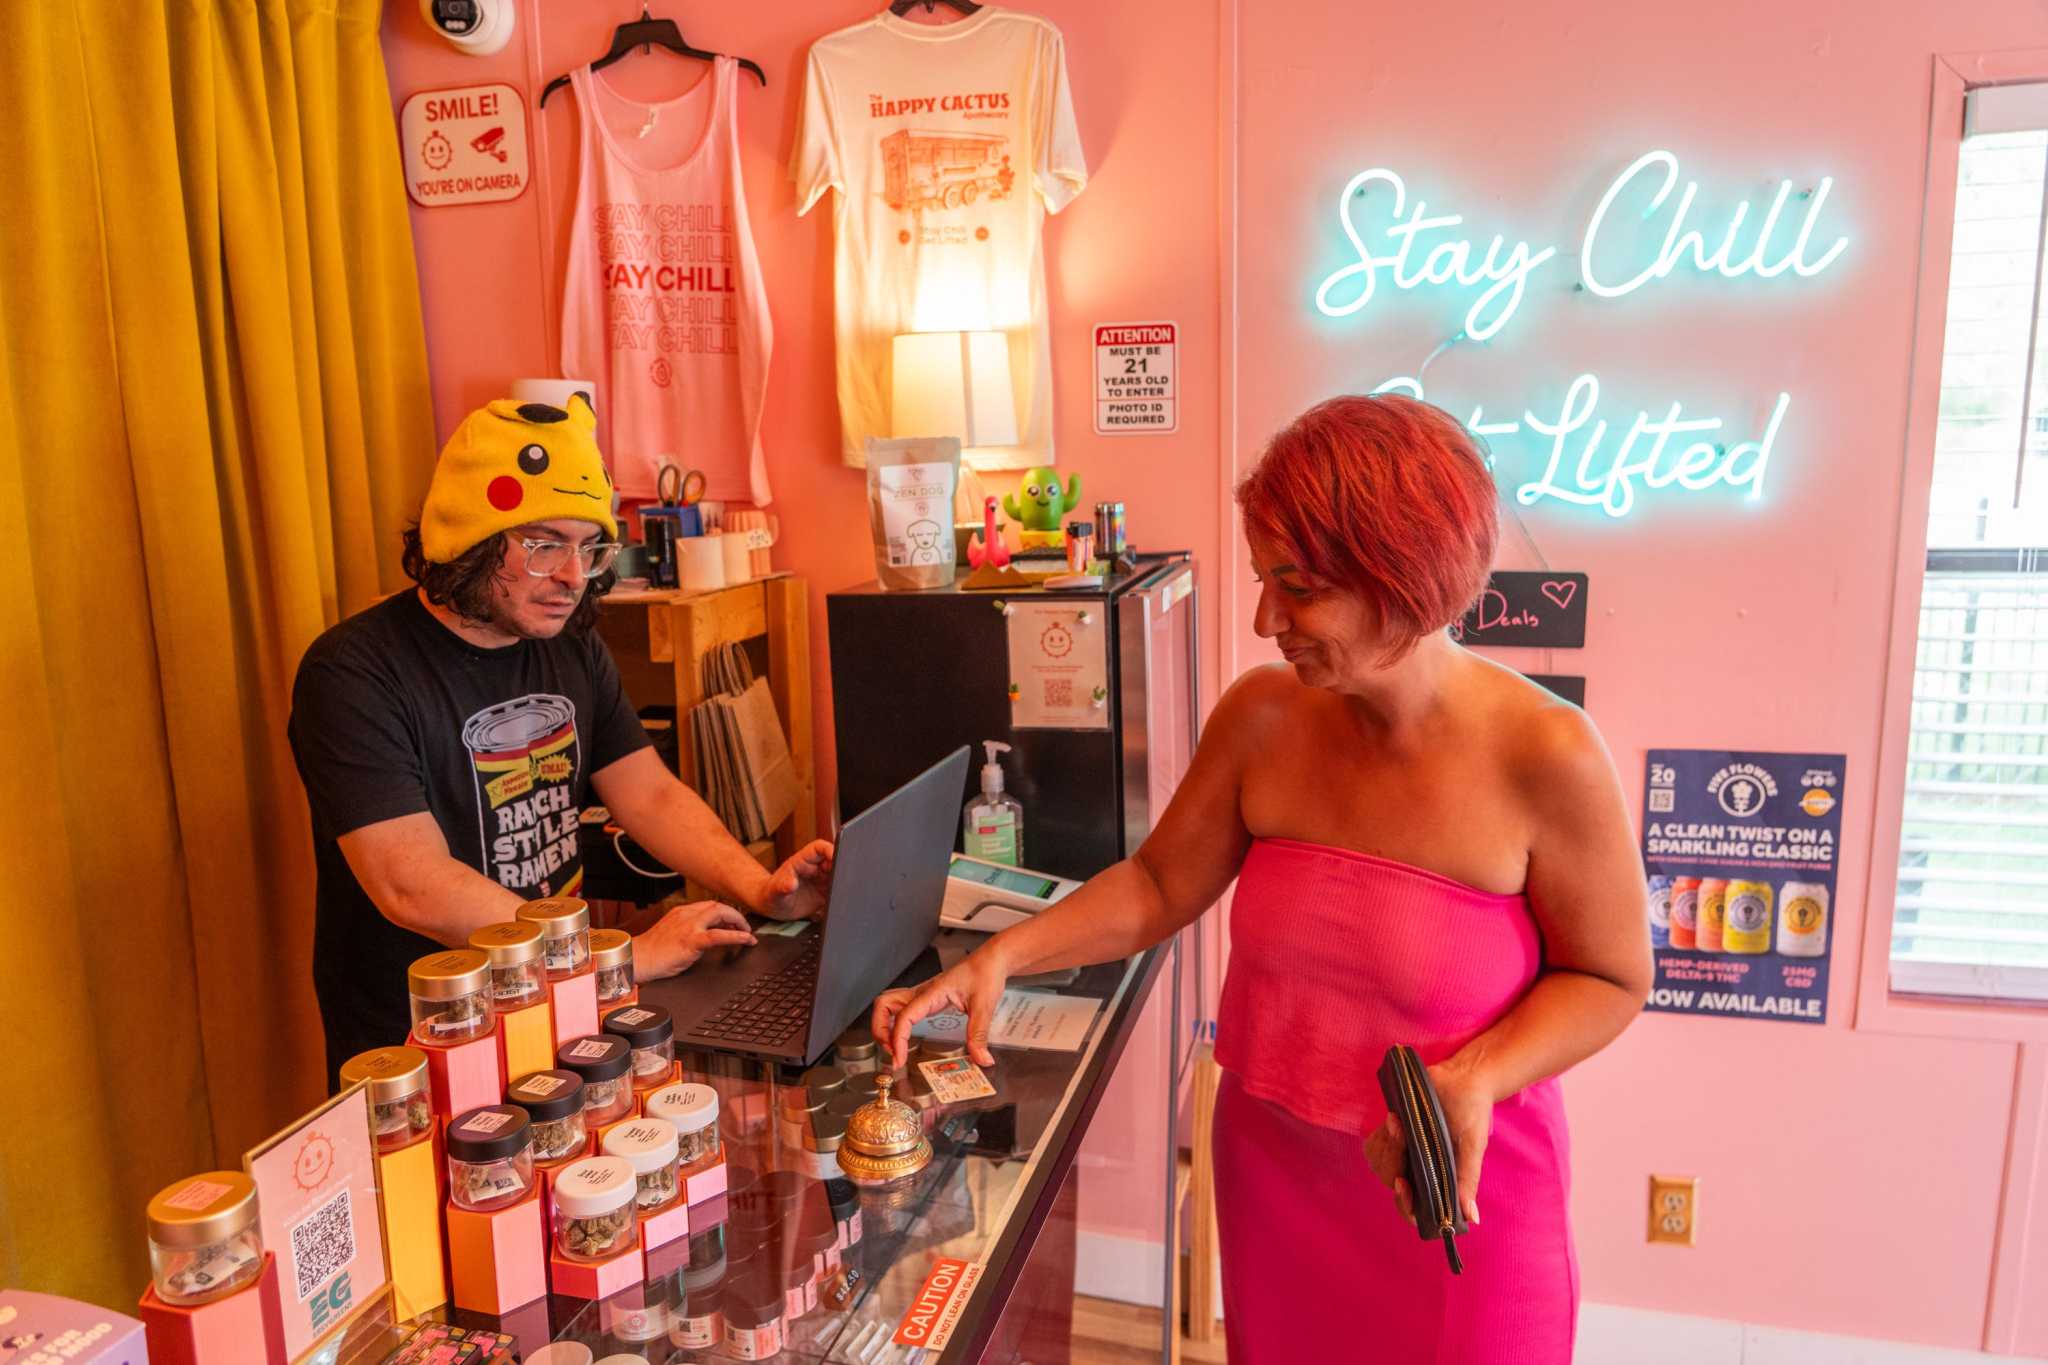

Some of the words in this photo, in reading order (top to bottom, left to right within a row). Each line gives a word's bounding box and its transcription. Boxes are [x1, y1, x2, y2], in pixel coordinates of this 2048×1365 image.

[425, 92, 499, 122] SMILE!
[870, 97, 937, 118] HAPPY
[940, 92, 1010, 111] CACTUS
[456, 178, 473, 194] ON
[474, 173, 521, 192] CAMERA
[1315, 167, 1556, 341] Stay
[1580, 149, 1850, 298] Chill
[655, 265, 736, 293] CHILL
[1100, 326, 1172, 344] ATTENTION
[1109, 346, 1142, 356] MUST
[1146, 346, 1161, 356] BE
[1124, 358, 1148, 374] 21
[1103, 376, 1142, 387] YEARS
[1145, 375, 1169, 386] OLD
[1107, 388, 1123, 398] TO
[1126, 387, 1165, 397] ENTER
[1108, 403, 1148, 413] PHOTO
[1151, 402, 1163, 412] ID
[1106, 414, 1166, 425] REQUIRED
[1516, 373, 1791, 517] Lifted
[1477, 588, 1539, 630] Deals
[1650, 767, 1676, 784] 20
[1648, 822, 1662, 837] A
[1664, 823, 1724, 840] CLEAN
[1727, 826, 1786, 843] TWIST
[1787, 828, 1816, 844] ON
[1819, 829, 1834, 845] A
[1647, 838, 1749, 857] SPARKLING
[1752, 843, 1833, 861] CLASSIC
[1697, 991, 1822, 1018] AVAILABLE
[903, 1263, 961, 1340] CAUTION
[942, 1319, 953, 1335] NOT
[957, 1288, 968, 1300] ON
